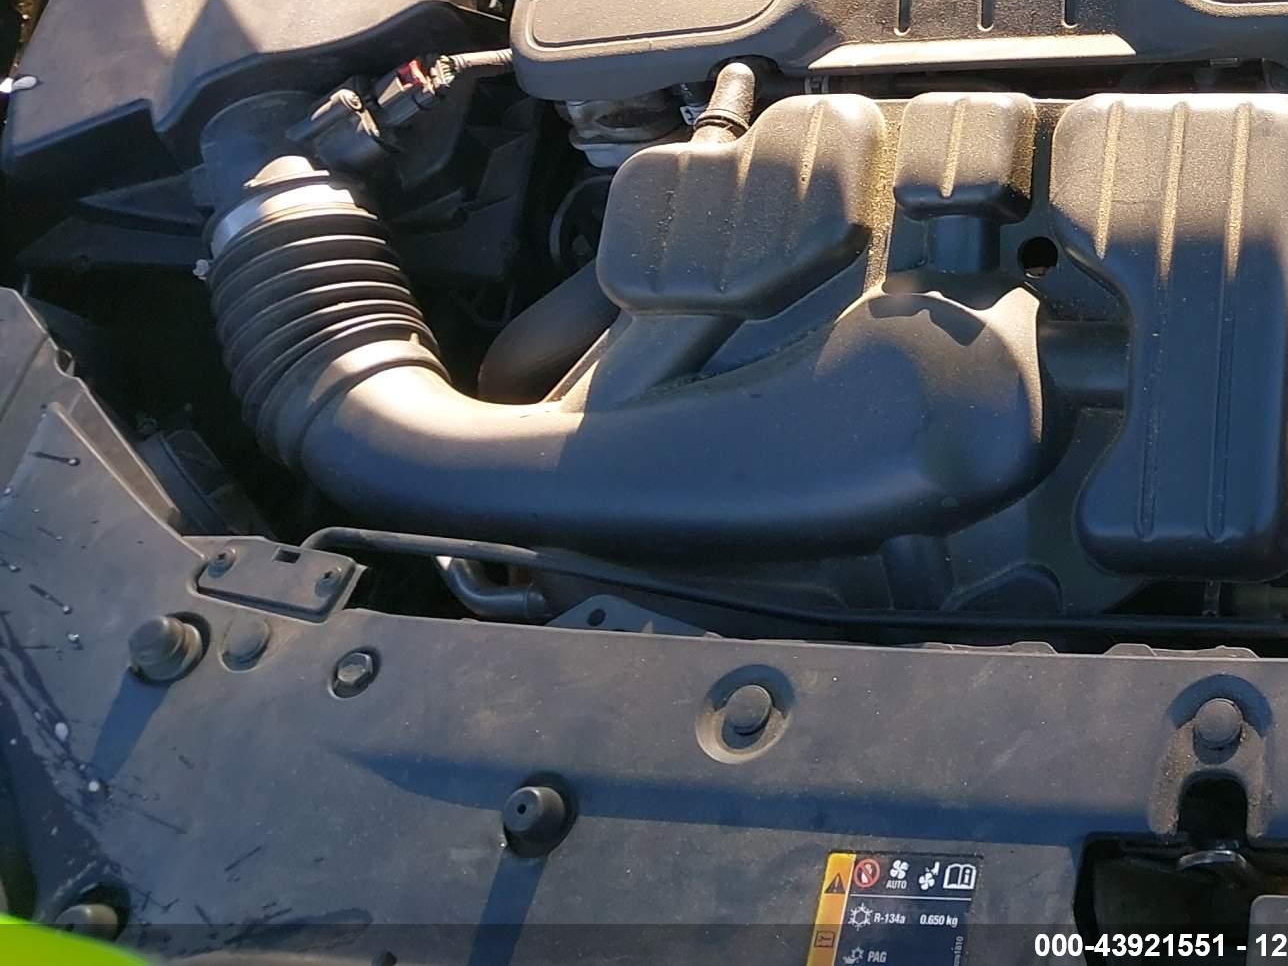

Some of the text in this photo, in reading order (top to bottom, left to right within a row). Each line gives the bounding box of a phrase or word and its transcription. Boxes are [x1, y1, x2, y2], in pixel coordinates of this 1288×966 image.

[885, 879, 908, 890] AUTO
[873, 912, 958, 929] R-134a 0.650 kg
[867, 950, 888, 964] PAG
